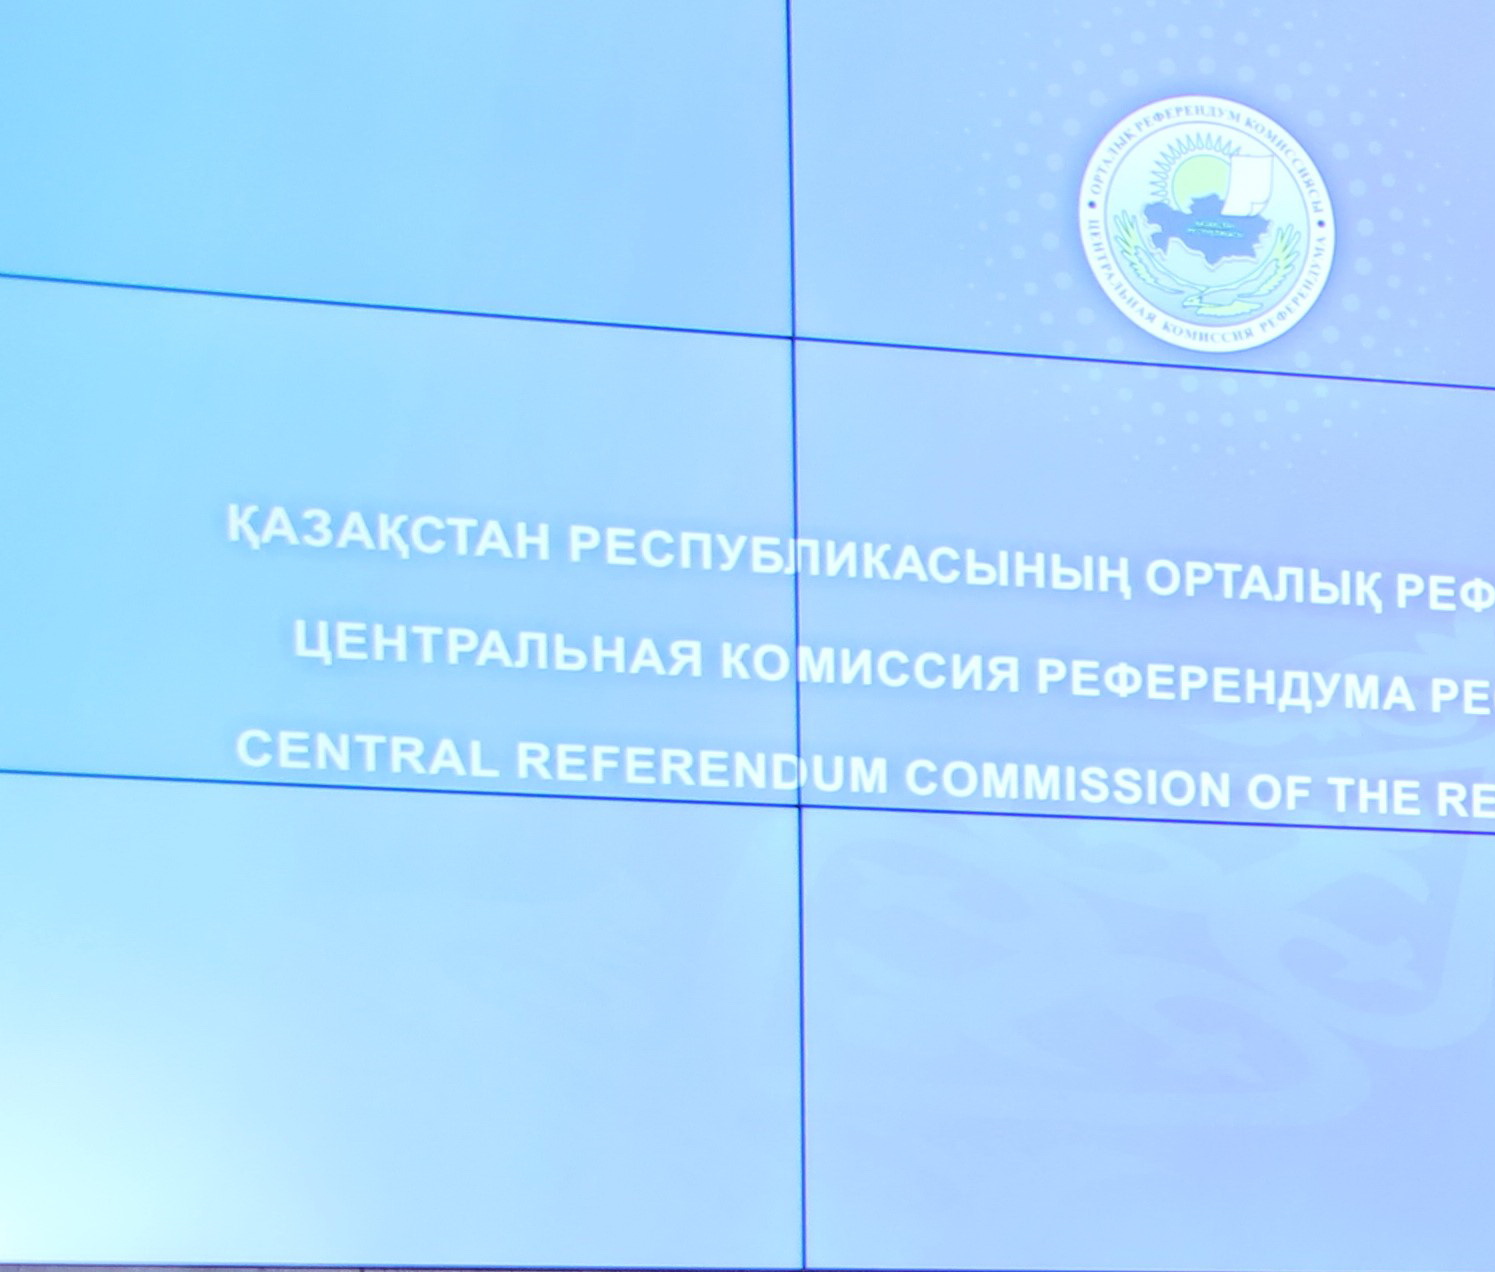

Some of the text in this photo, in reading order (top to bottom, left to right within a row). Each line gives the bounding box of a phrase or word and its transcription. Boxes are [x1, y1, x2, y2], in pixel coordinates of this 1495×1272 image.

[1135, 105, 1241, 132] РЕФЕРЕНДУМ
[1245, 119, 1324, 214] КОМИССИЯСЫ
[1089, 219, 1327, 343] ЦЕНТРАЛЬНАЯ КОМИССИЯ РЕФЕРЕНДУМА
[227, 502, 550, 563] ҚАЗАҚСТАН
[569, 524, 1133, 601] РЕСПУБЛИКАСЫНЫҢ
[1147, 559, 1383, 615] ОРТАЛЫҚ
[292, 618, 702, 679] ЦЕНТРАЛЬНАЯ
[720, 640, 1020, 694] КОМИССИЯ
[1036, 657, 1417, 718] РЕФЕРЕНДУМА
[234, 727, 500, 779] CENTRAL
[516, 740, 888, 796] REFERENDUM
[905, 758, 1231, 808] COMMISSION
[1245, 772, 1312, 812] OF
[1327, 778, 1422, 817] THE
